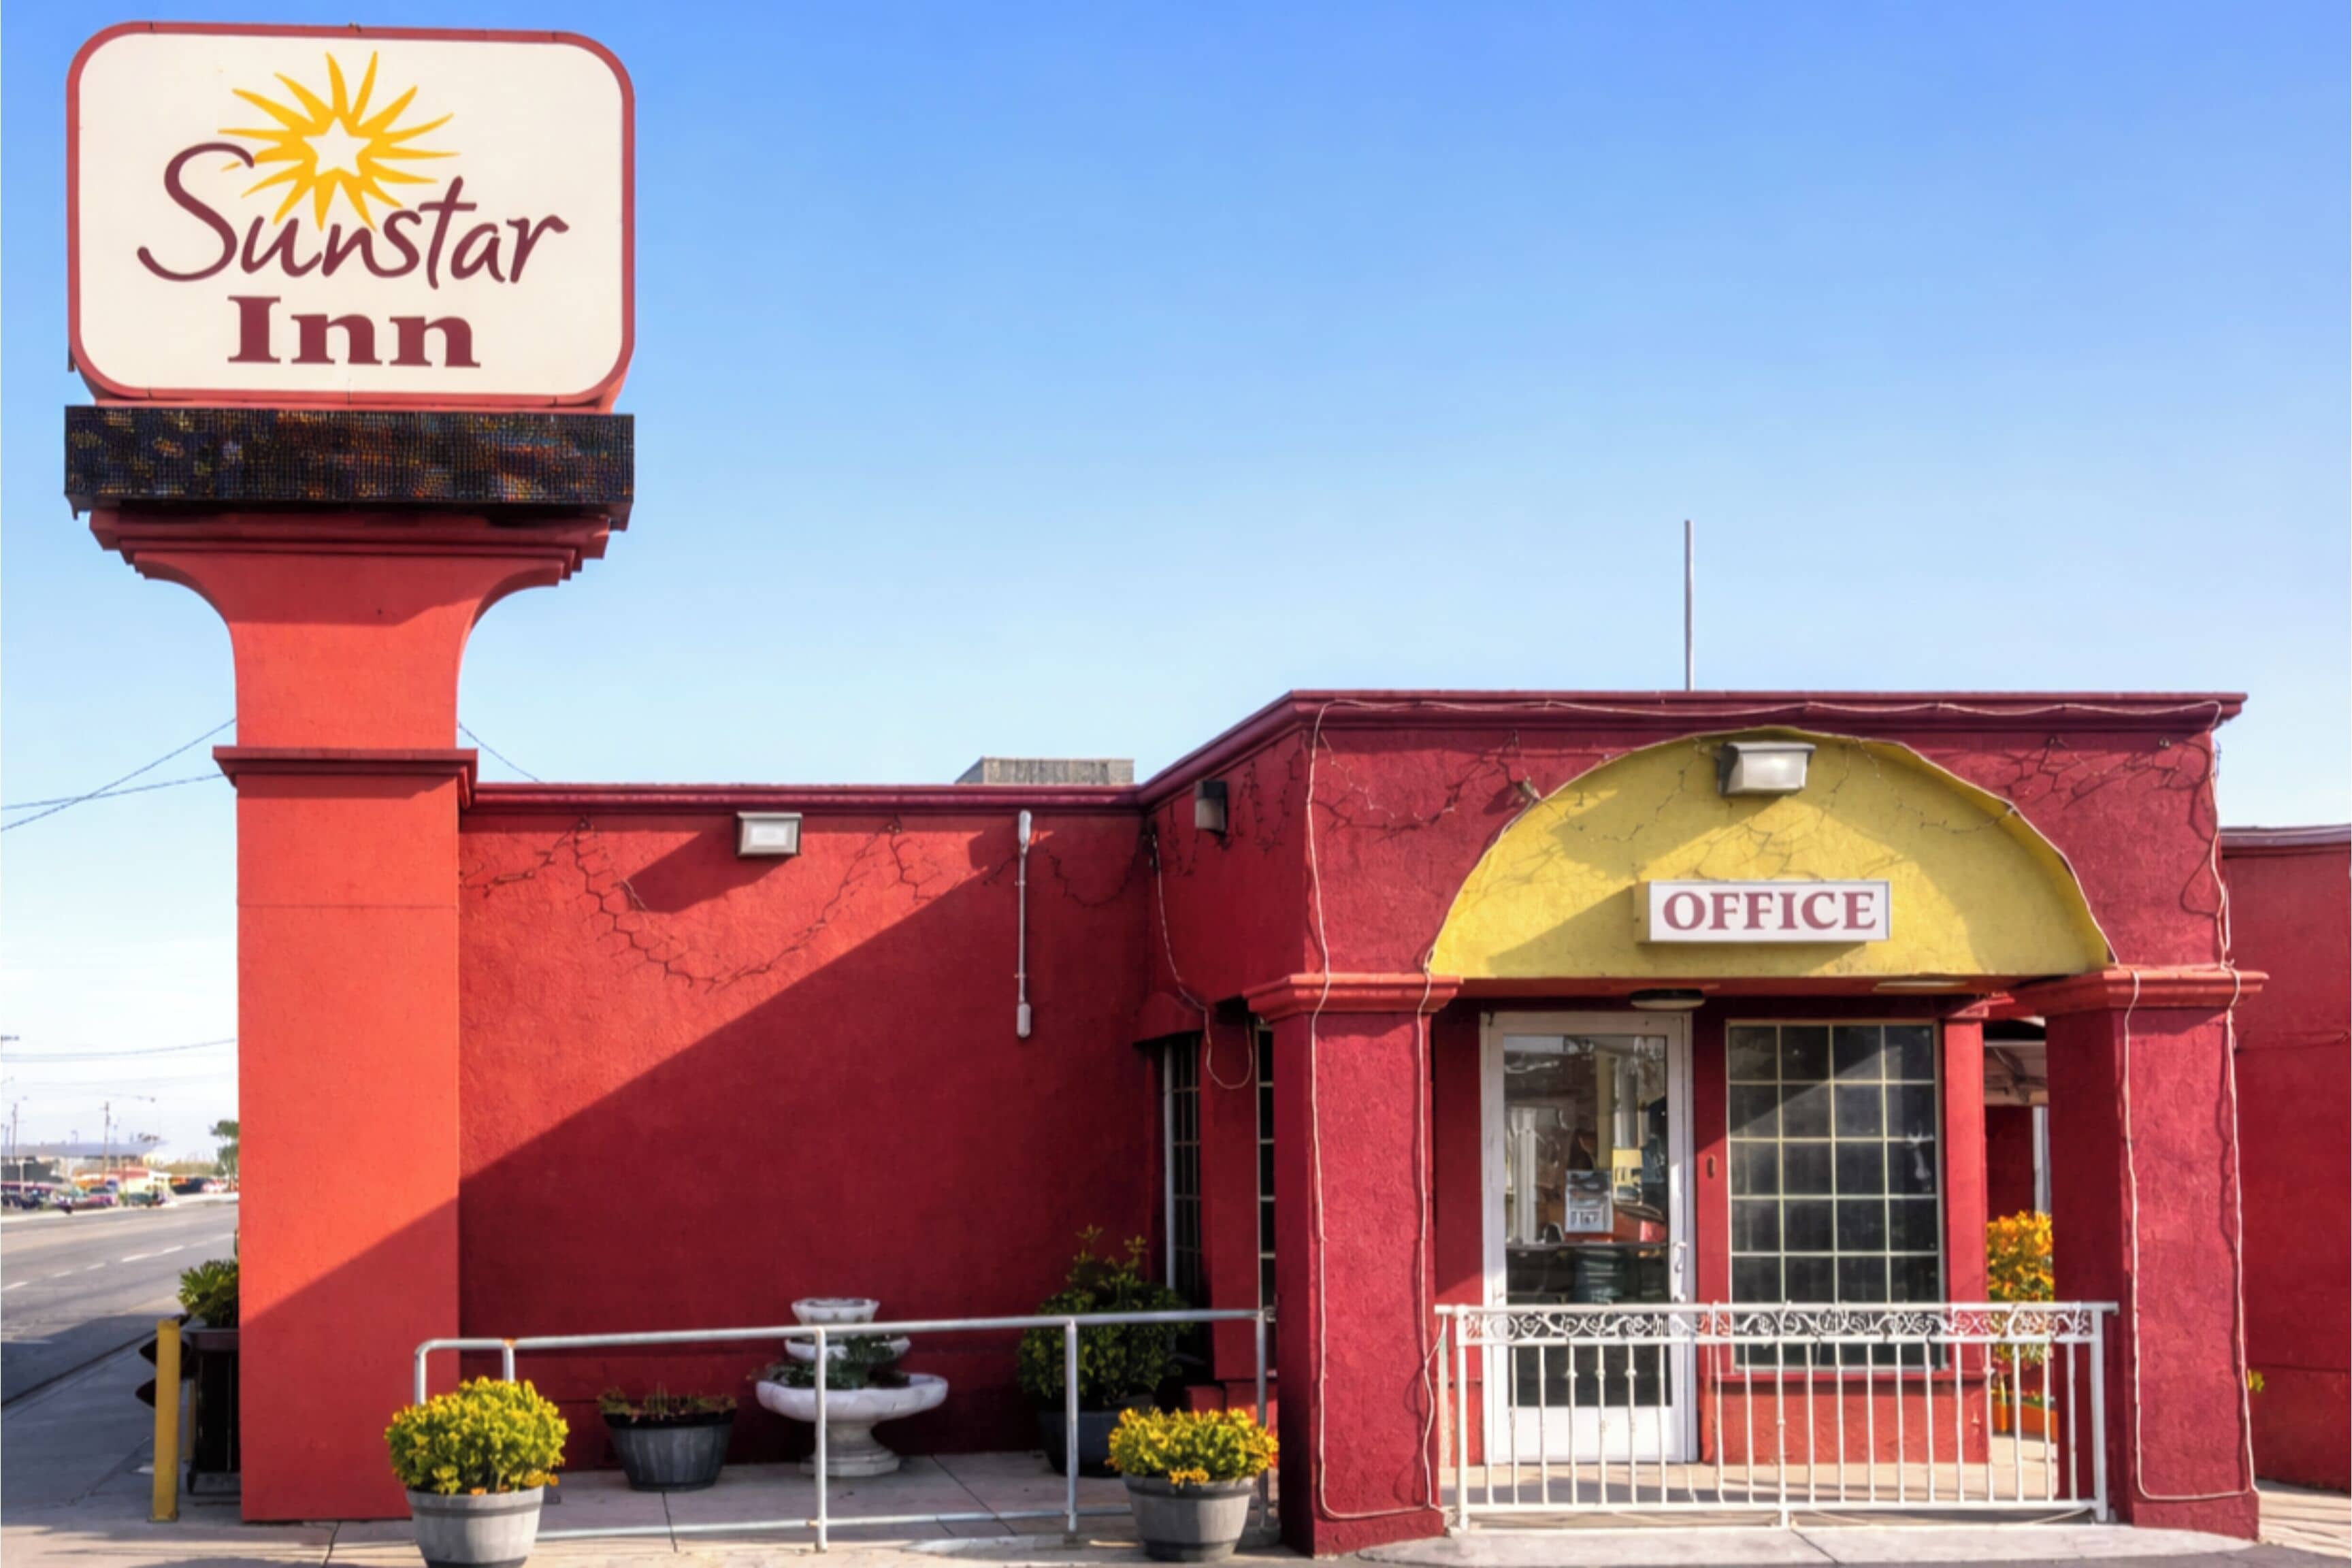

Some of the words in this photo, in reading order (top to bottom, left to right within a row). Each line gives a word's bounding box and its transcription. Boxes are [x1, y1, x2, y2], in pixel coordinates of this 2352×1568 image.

[137, 142, 570, 289] Sunstar
[227, 295, 481, 368] Inn
[1663, 891, 1877, 930] OFFICE
